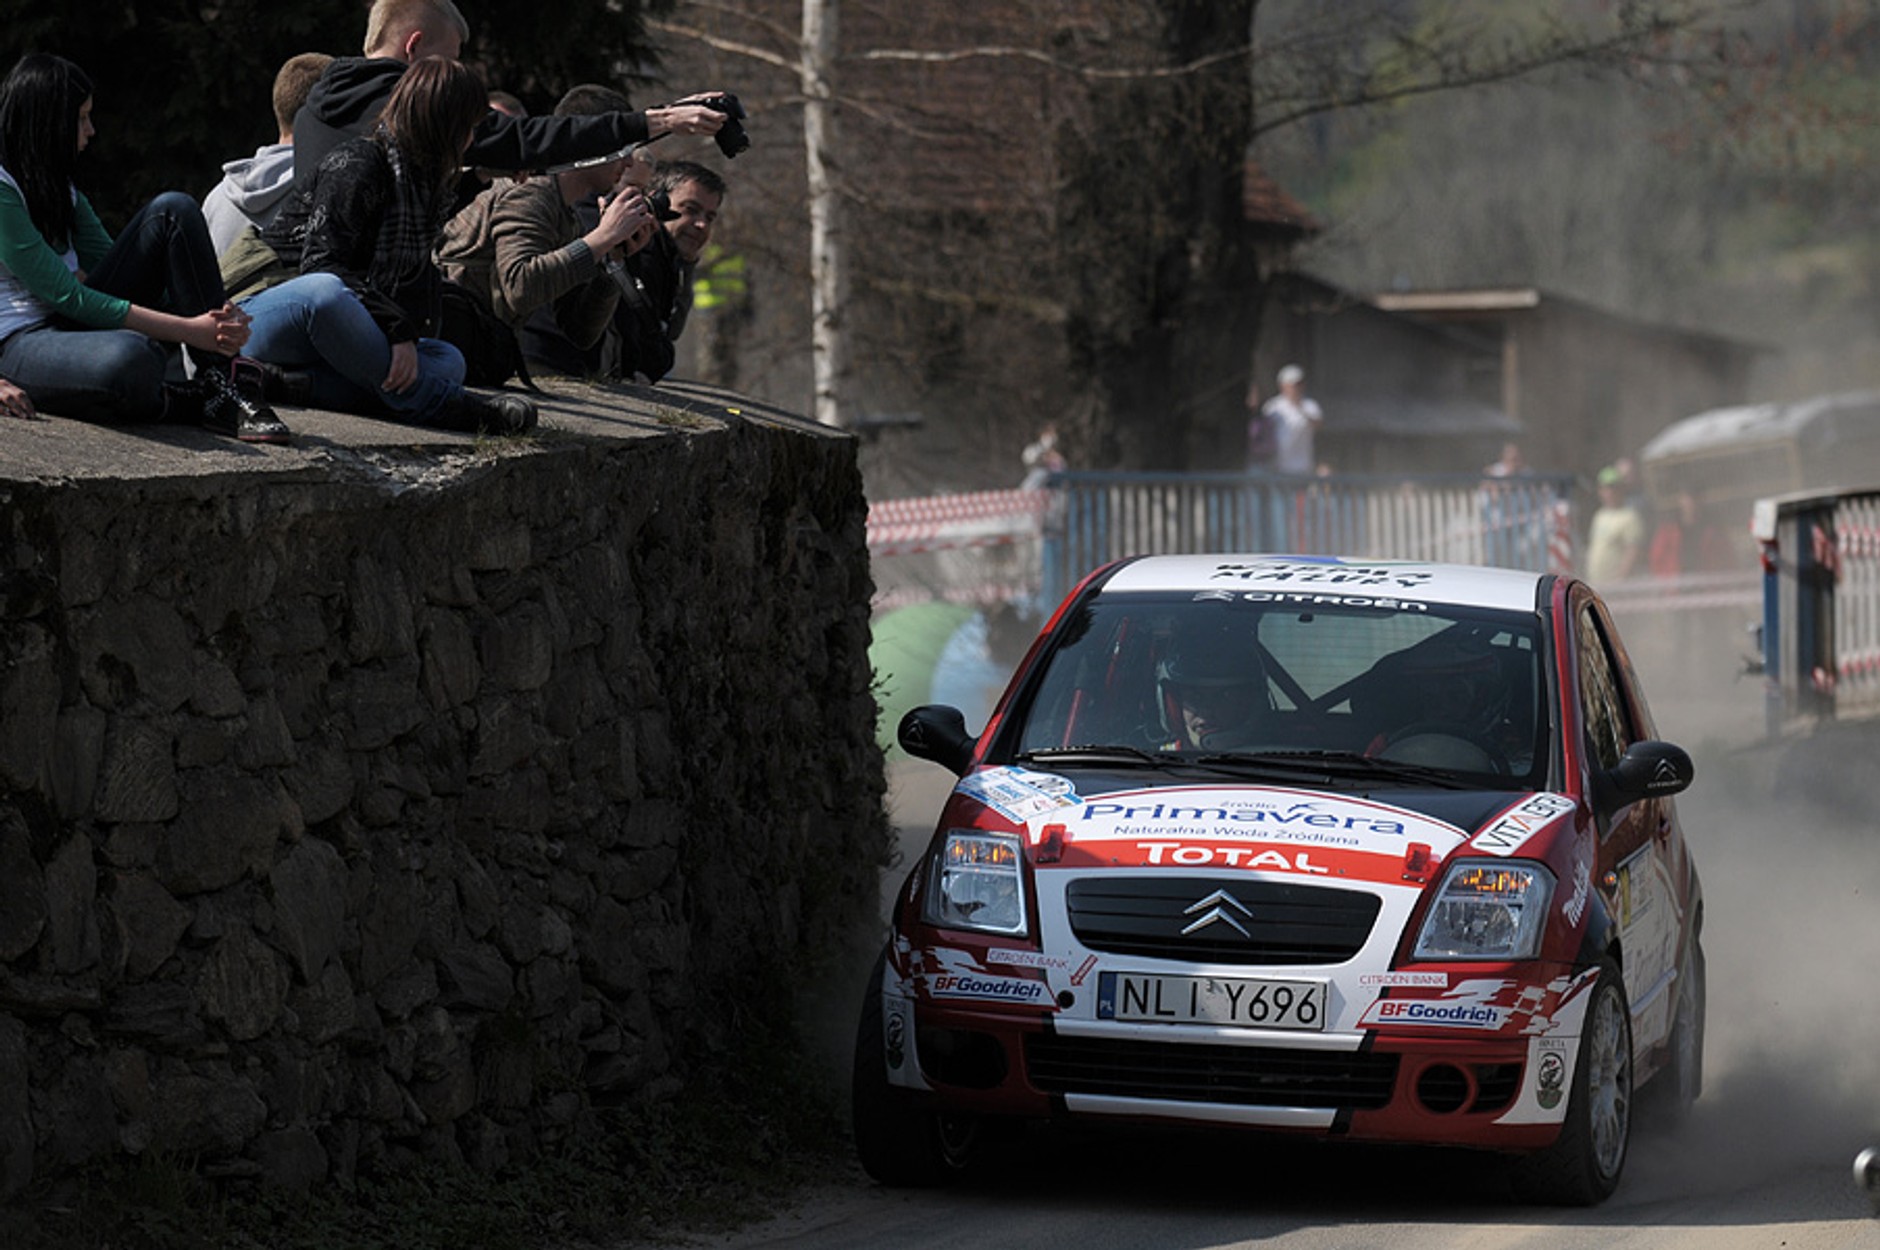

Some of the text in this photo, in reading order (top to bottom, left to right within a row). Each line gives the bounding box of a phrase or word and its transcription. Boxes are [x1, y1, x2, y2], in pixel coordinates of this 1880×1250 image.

[1082, 803, 1405, 836] Primavera
[1113, 825, 1208, 836] Naturalna
[1213, 826, 1268, 838] Woda
[1136, 842, 1329, 874] TOTAL
[934, 977, 1042, 998] BFGoodrich
[1225, 983, 1318, 1024] Y696
[1379, 1002, 1498, 1023] BFGoodrich
